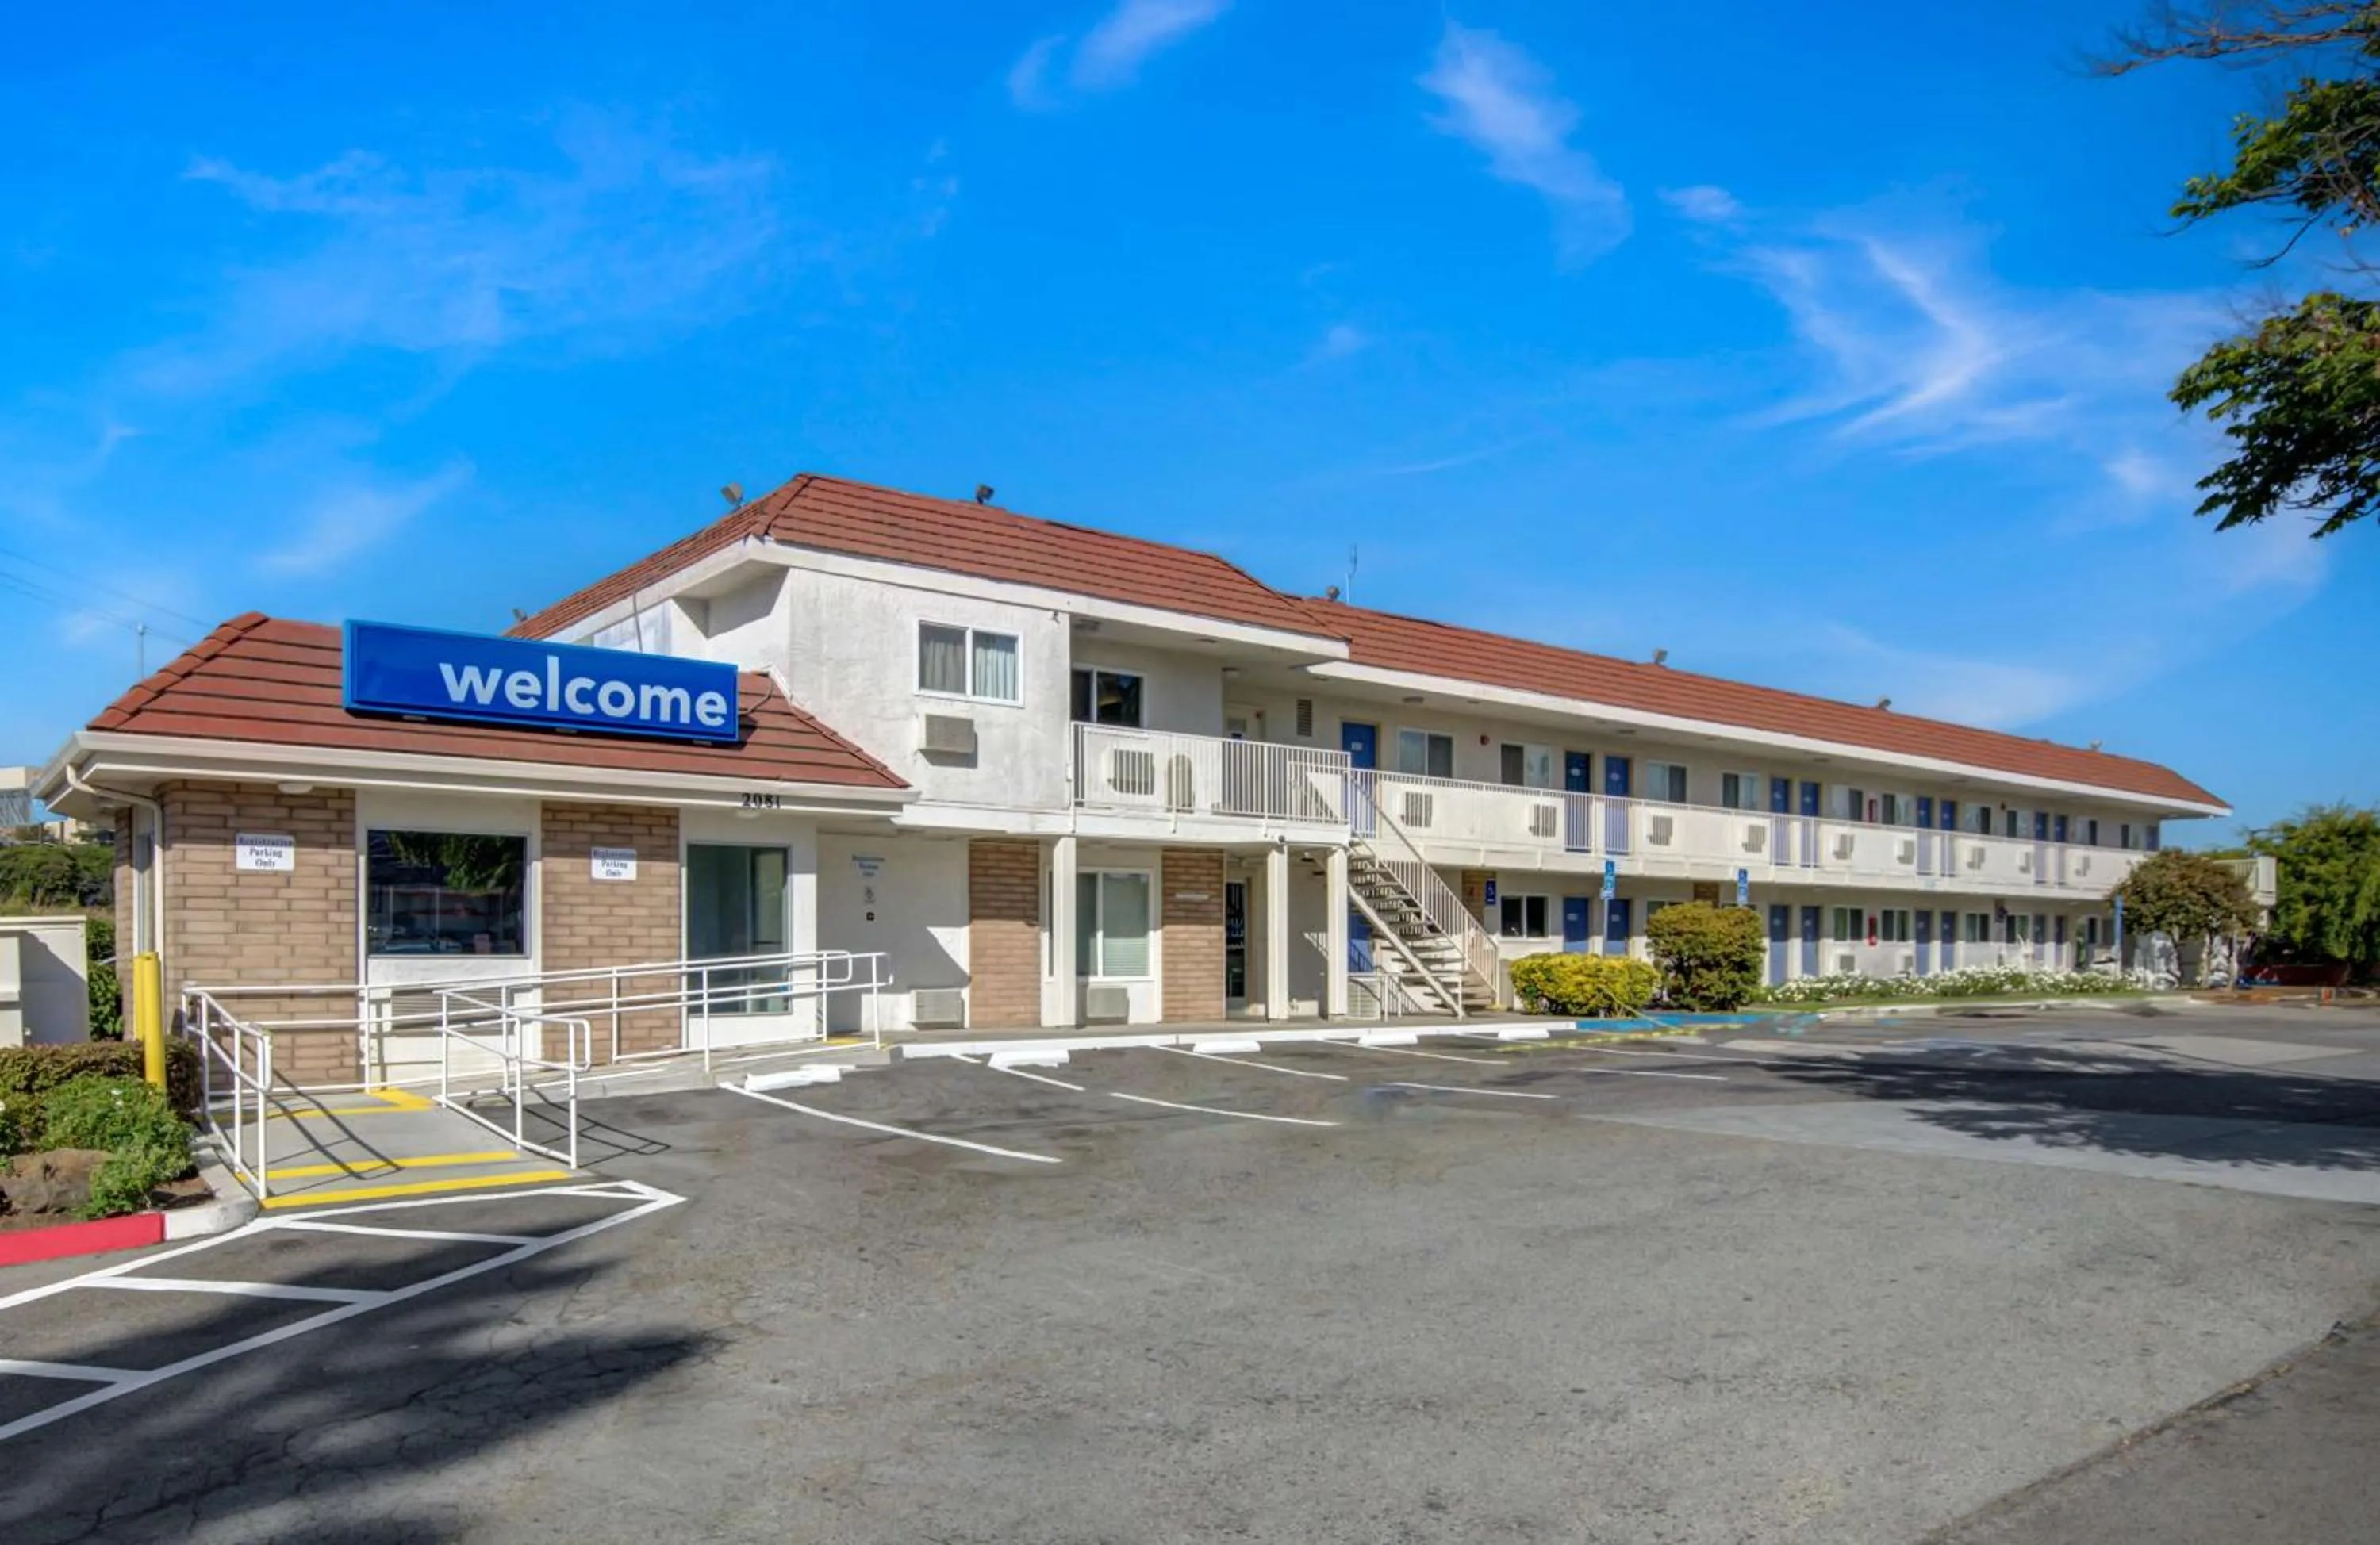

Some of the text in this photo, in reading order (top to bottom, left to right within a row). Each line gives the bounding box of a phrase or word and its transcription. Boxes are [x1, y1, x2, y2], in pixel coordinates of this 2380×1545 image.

[439, 655, 727, 726] welcome
[742, 792, 780, 808] 2081
[249, 848, 282, 858] Parking
